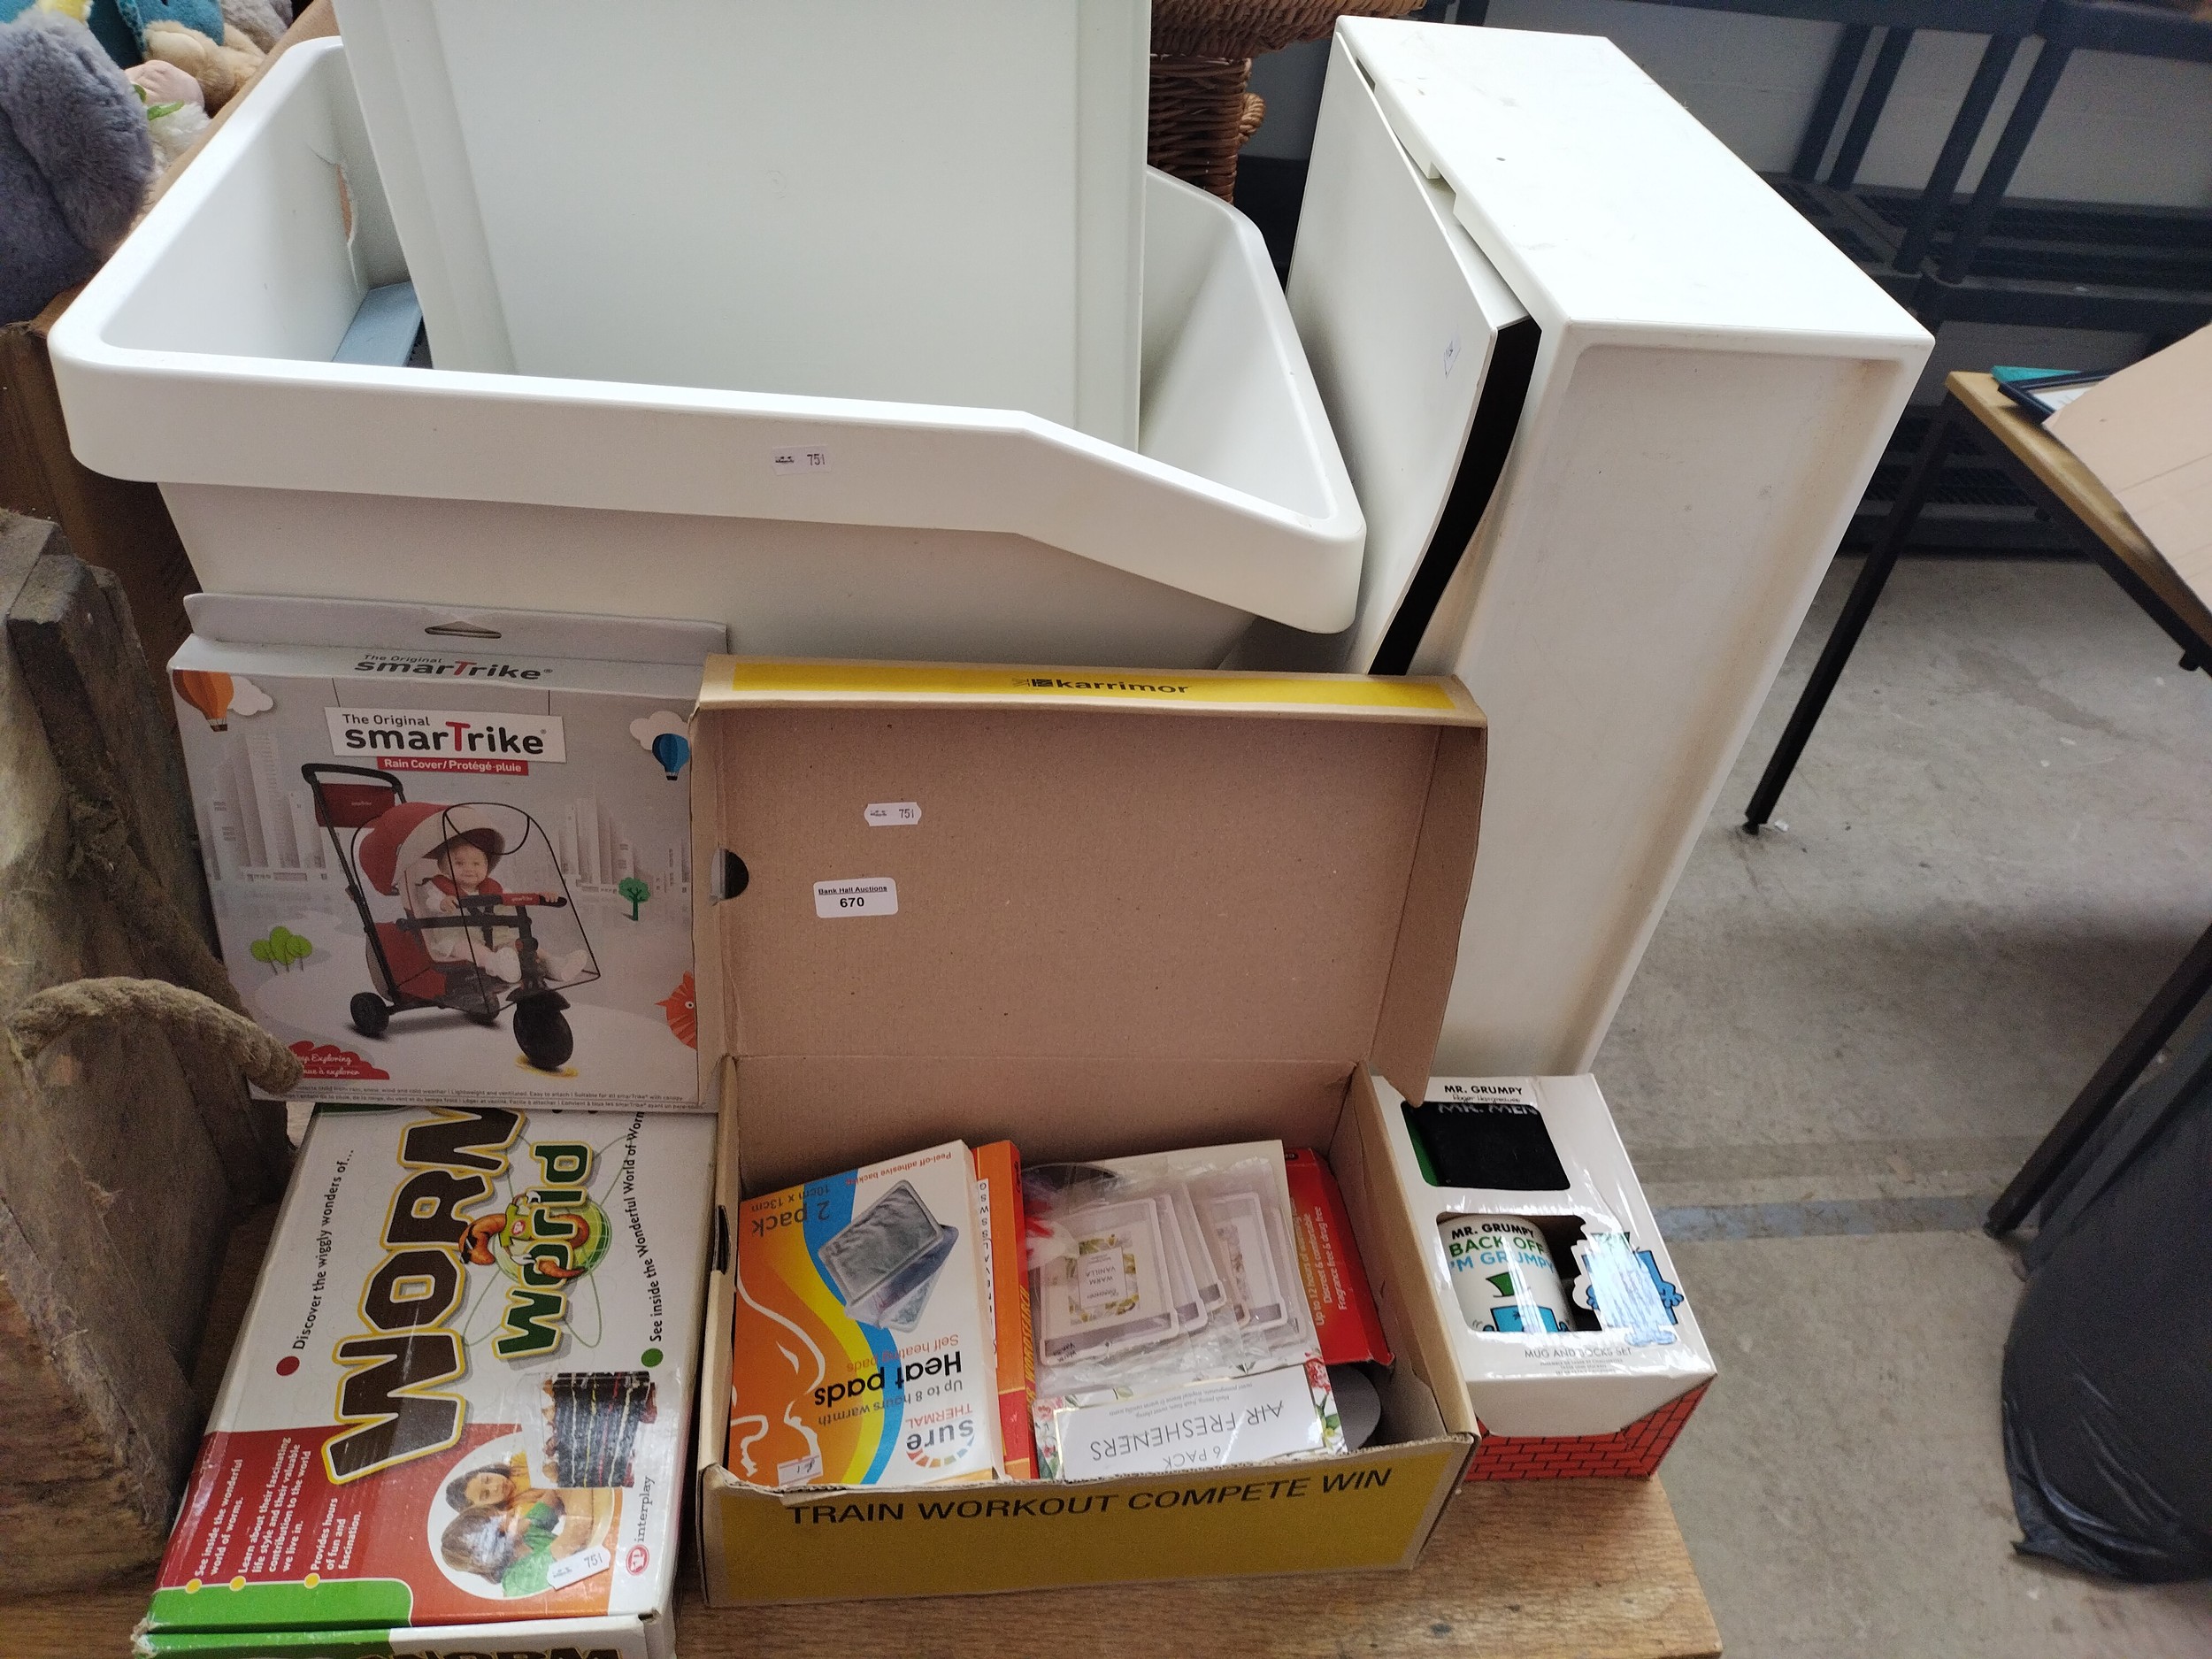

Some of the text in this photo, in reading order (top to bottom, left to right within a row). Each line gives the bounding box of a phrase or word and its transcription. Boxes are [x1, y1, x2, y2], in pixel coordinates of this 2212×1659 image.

[806, 453, 826, 466] 751
[390, 655, 442, 664] Original
[1056, 679, 1189, 694] karrimor
[342, 713, 431, 727] The Original
[384, 758, 409, 769] Rain
[899, 808, 915, 819] 751
[839, 896, 865, 908] 670
[1444, 1085, 1523, 1095] MR. GRUMPY
[624, 1144, 637, 1157] of
[622, 1159, 636, 1194] World
[845, 1150, 953, 1187] Peel-off adhesive backing
[321, 1177, 342, 1226] wonders
[750, 1195, 783, 1214] 13cm
[798, 1185, 832, 1202] 10cm
[750, 1200, 831, 1237] 2 pack
[1314, 1206, 1323, 1222] free
[624, 1195, 649, 1259] Wonderful
[1319, 1222, 1330, 1242] drug
[1451, 1223, 1534, 1240] MR. GRUMPY
[315, 1230, 333, 1270] wiggly
[1302, 1252, 1310, 1263] of
[1448, 1235, 1545, 1257] BACK OFF
[643, 1258, 657, 1279] the
[1303, 1213, 1333, 1304] Discreet & comfortable
[1326, 1250, 1335, 1267] free
[311, 1271, 326, 1293] the
[1085, 1265, 1117, 1278] VANILLA
[1088, 1275, 1114, 1286] WARM
[1304, 1263, 1315, 1287] hours
[647, 1279, 663, 1317] inside
[1309, 1287, 1318, 1299] 12
[1331, 1267, 1347, 1310] Fragrance
[1312, 1301, 1322, 1311] to
[292, 1294, 323, 1351] Discover
[1315, 1311, 1325, 1326] Up
[649, 1320, 663, 1342] See
[1018, 1285, 1036, 1384] WORDSEARCH
[846, 1333, 960, 1374] Self heating pads
[1524, 1348, 1550, 1359] MUG
[1553, 1348, 1577, 1358] AND
[1615, 1347, 1632, 1356] SET
[813, 1351, 963, 1409] Heat pads
[818, 1379, 964, 1427] Up to 8 hours warmth
[904, 1402, 974, 1429] THERMAL
[904, 1417, 975, 1455] sure
[1088, 1400, 1285, 1462] AIR FRESHENERS
[1162, 1445, 1223, 1471] 6 PACK
[238, 1436, 292, 1573] Learn about their fascinating
[788, 1467, 1395, 1525] TRAIN WORKOUT COMPETE WIN
[194, 1459, 243, 1577] See inside the wonderful
[252, 1443, 302, 1573] life style and their valuable
[268, 1450, 311, 1573] contribution to the world
[634, 1475, 656, 1543] interplay
[286, 1535, 299, 1555] live
[311, 1497, 339, 1571] Provides hours
[326, 1518, 347, 1571] of fun and
[338, 1510, 363, 1571] fascination.
[211, 1547, 227, 1577] world
[222, 1533, 232, 1545] of
[282, 1555, 294, 1572] we
[584, 1553, 603, 1569] 751
